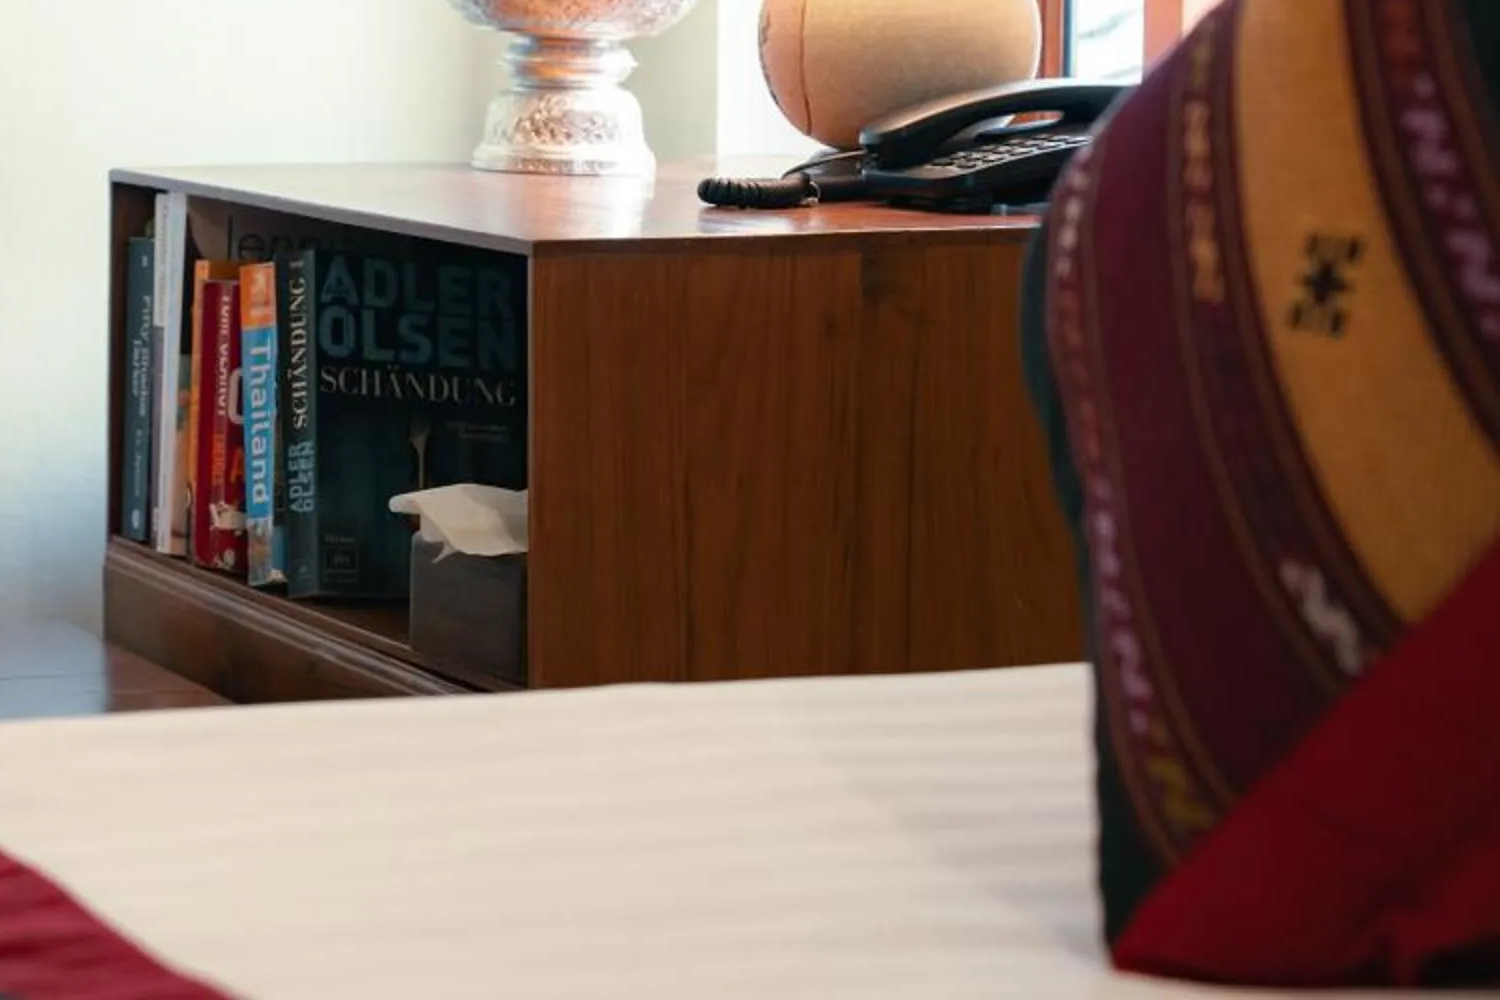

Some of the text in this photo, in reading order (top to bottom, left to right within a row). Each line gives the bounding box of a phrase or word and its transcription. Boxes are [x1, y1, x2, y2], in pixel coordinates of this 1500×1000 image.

[320, 255, 514, 321] ADLER
[287, 277, 309, 430] SCHÄNDUNG
[319, 303, 517, 372] OLSEN
[250, 336, 271, 504] Thailand
[319, 363, 517, 408] SCHÄNDUNG
[287, 444, 303, 513] ADLER
